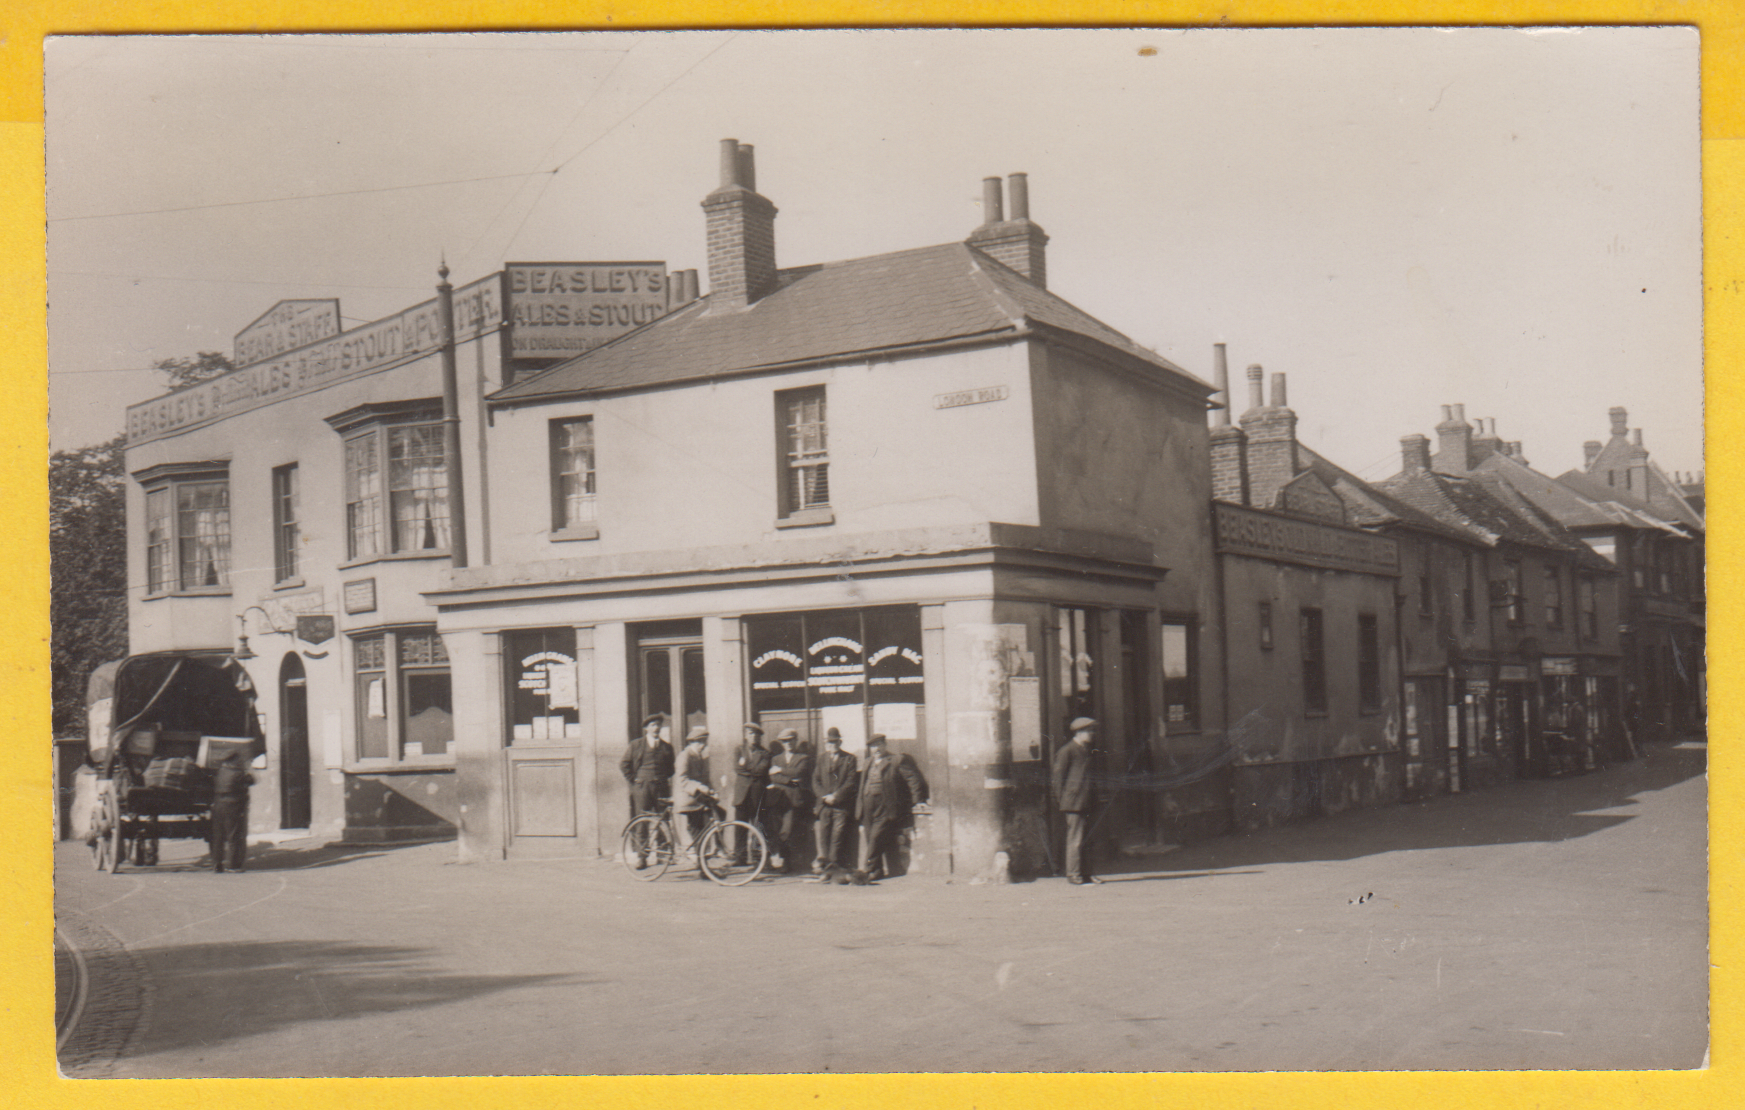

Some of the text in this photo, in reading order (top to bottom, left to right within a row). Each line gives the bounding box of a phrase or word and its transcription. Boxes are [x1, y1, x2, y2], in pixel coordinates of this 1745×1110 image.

[510, 268, 663, 294] BEASLEY'S
[511, 302, 664, 327] ALES & STOUT
[529, 337, 586, 350] DRAUGHT
[251, 359, 292, 397] ALES
[341, 324, 401, 371] STOUT
[938, 388, 1002, 408] LONDON ROAD
